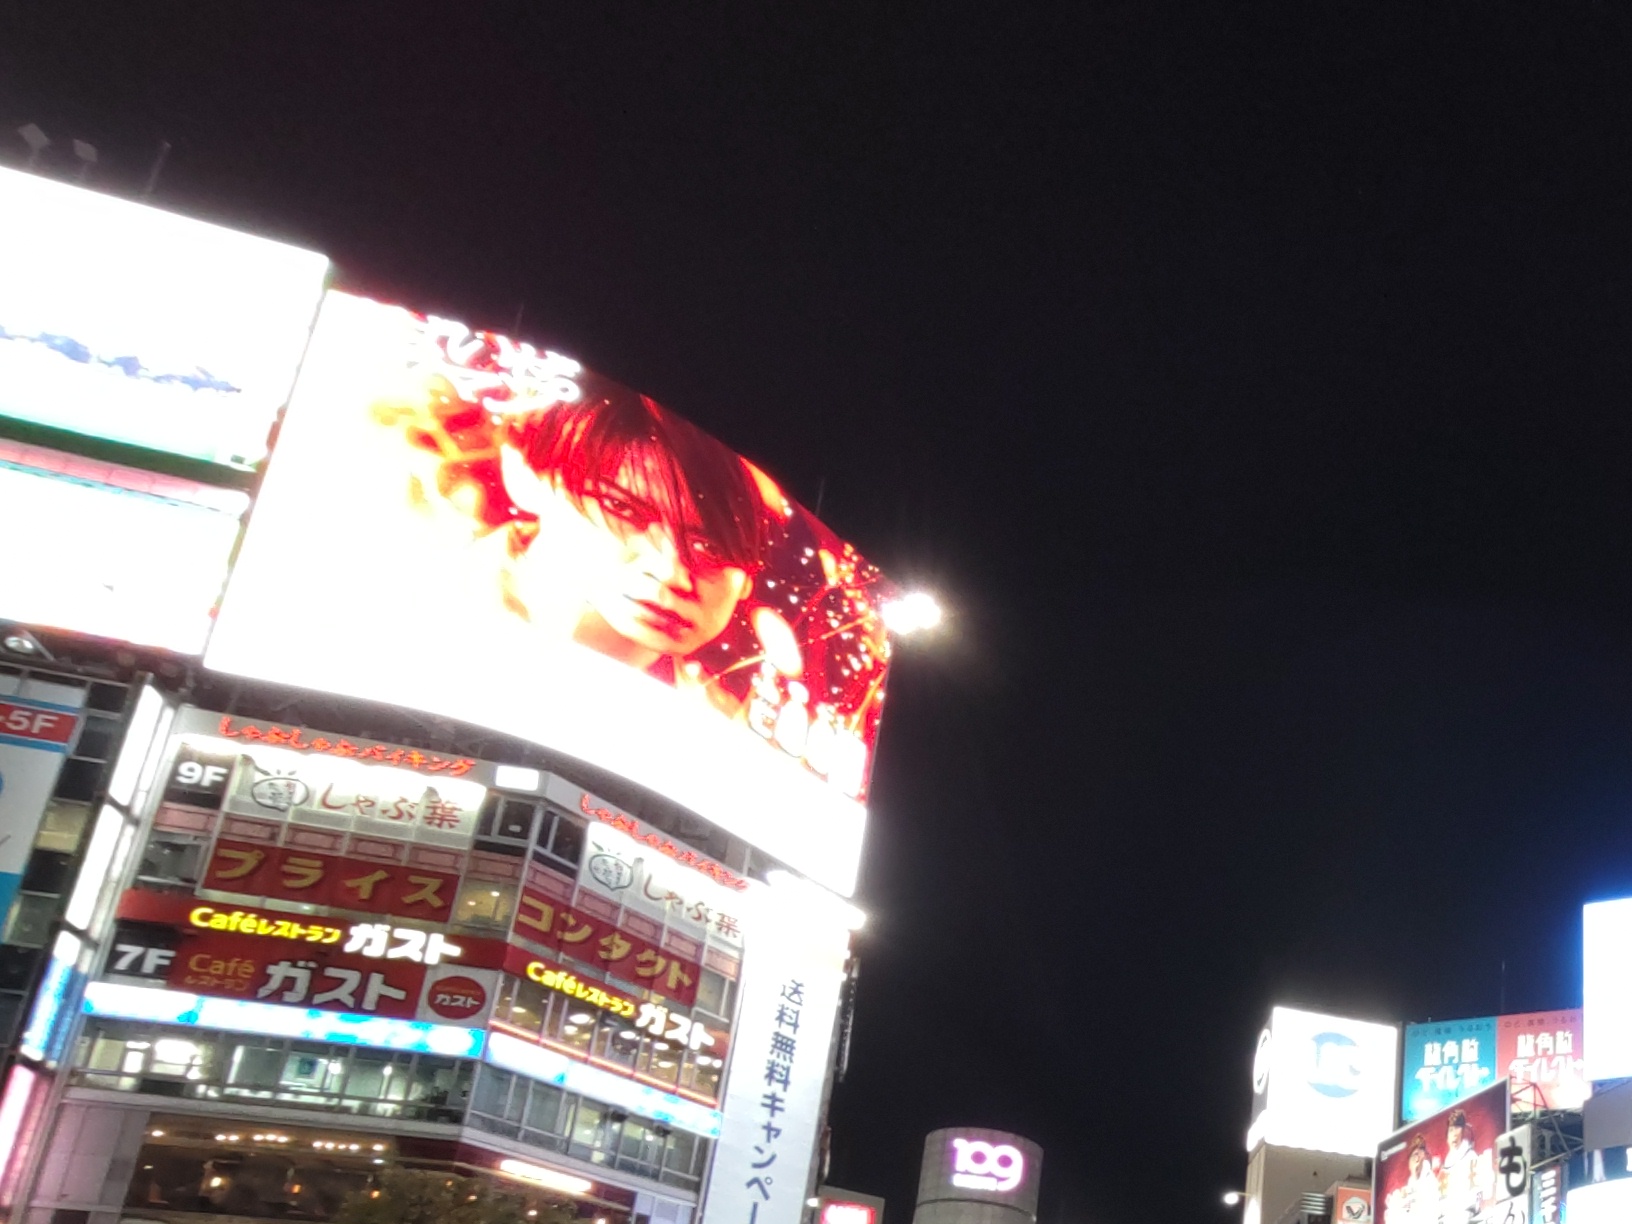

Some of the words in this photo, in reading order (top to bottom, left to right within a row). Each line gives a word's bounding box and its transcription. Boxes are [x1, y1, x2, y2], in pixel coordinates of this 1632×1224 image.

[218, 716, 477, 777] しゃぶしゃぶバイキング
[176, 761, 230, 789] 9F
[318, 783, 463, 831] しゃぶ葉
[214, 847, 450, 910] プライス
[112, 944, 176, 976] 7F
[188, 953, 257, 980] Café
[344, 922, 462, 965] ガスト
[517, 894, 693, 992] コンタクト
[257, 960, 406, 1011] ガスト
[634, 1000, 715, 1050] ガスト
[953, 1138, 1023, 1191] 109
